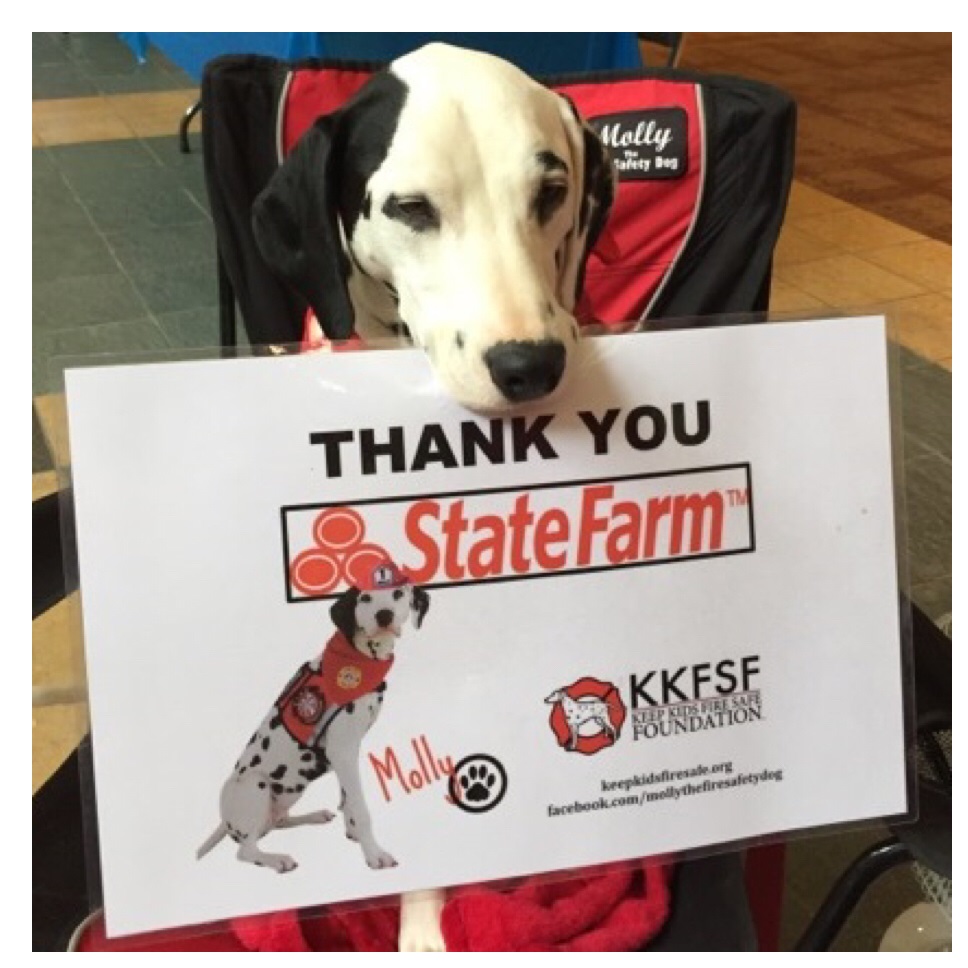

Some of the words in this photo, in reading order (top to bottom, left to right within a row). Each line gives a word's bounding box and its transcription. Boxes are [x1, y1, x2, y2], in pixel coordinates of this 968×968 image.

[601, 120, 673, 152] Molly
[655, 156, 678, 170] Dog
[309, 413, 559, 479] THANK
[577, 400, 711, 456] YOU
[629, 655, 760, 708] KKFSF
[631, 708, 664, 725] KEEP
[669, 702, 699, 718] KIDS
[700, 697, 730, 714] FIRE
[732, 691, 763, 708] SAFE
[633, 706, 763, 741] FOUNDATION
[368, 734, 460, 805] Molly
[600, 761, 733, 792] keepkidsfiresafe.org
[547, 769, 783, 817] facebook.com/mollythefiresafetydog
